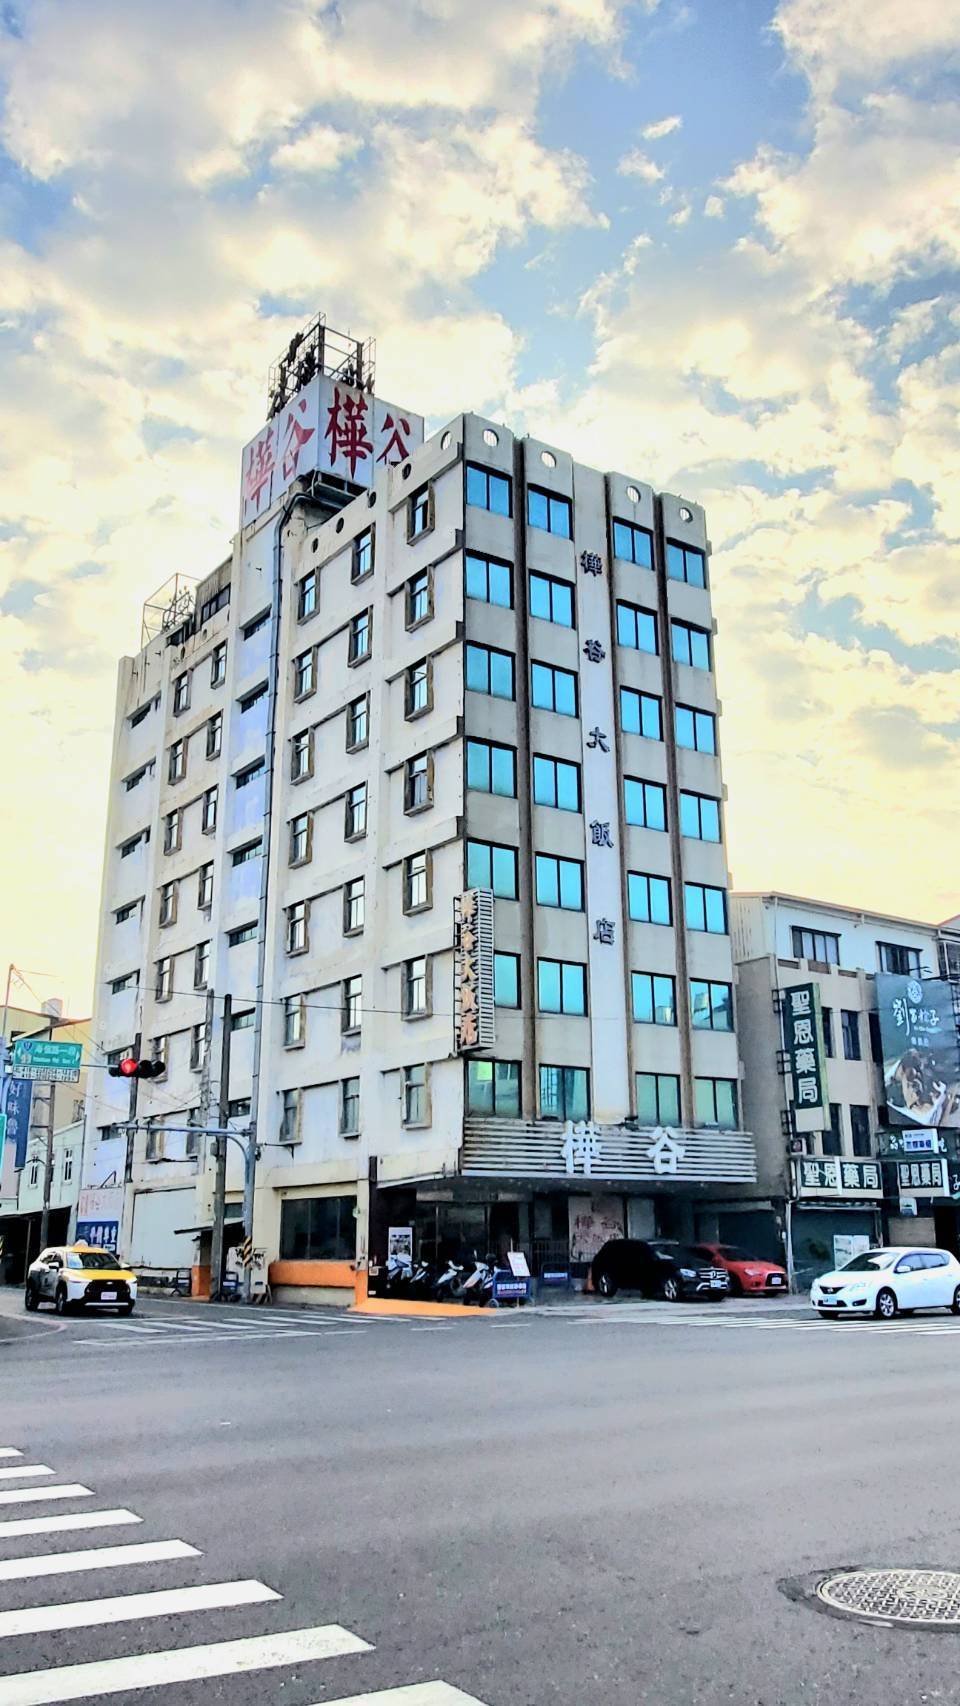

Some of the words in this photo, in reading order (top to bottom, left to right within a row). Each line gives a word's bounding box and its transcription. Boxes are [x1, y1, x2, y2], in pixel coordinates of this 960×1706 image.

[790, 990, 818, 1104] 聖恩藥局
[561, 1120, 685, 1175] 樺谷
[803, 1162, 878, 1189] 聖恩藥局
[900, 1163, 942, 1187] 聖恩藥局
